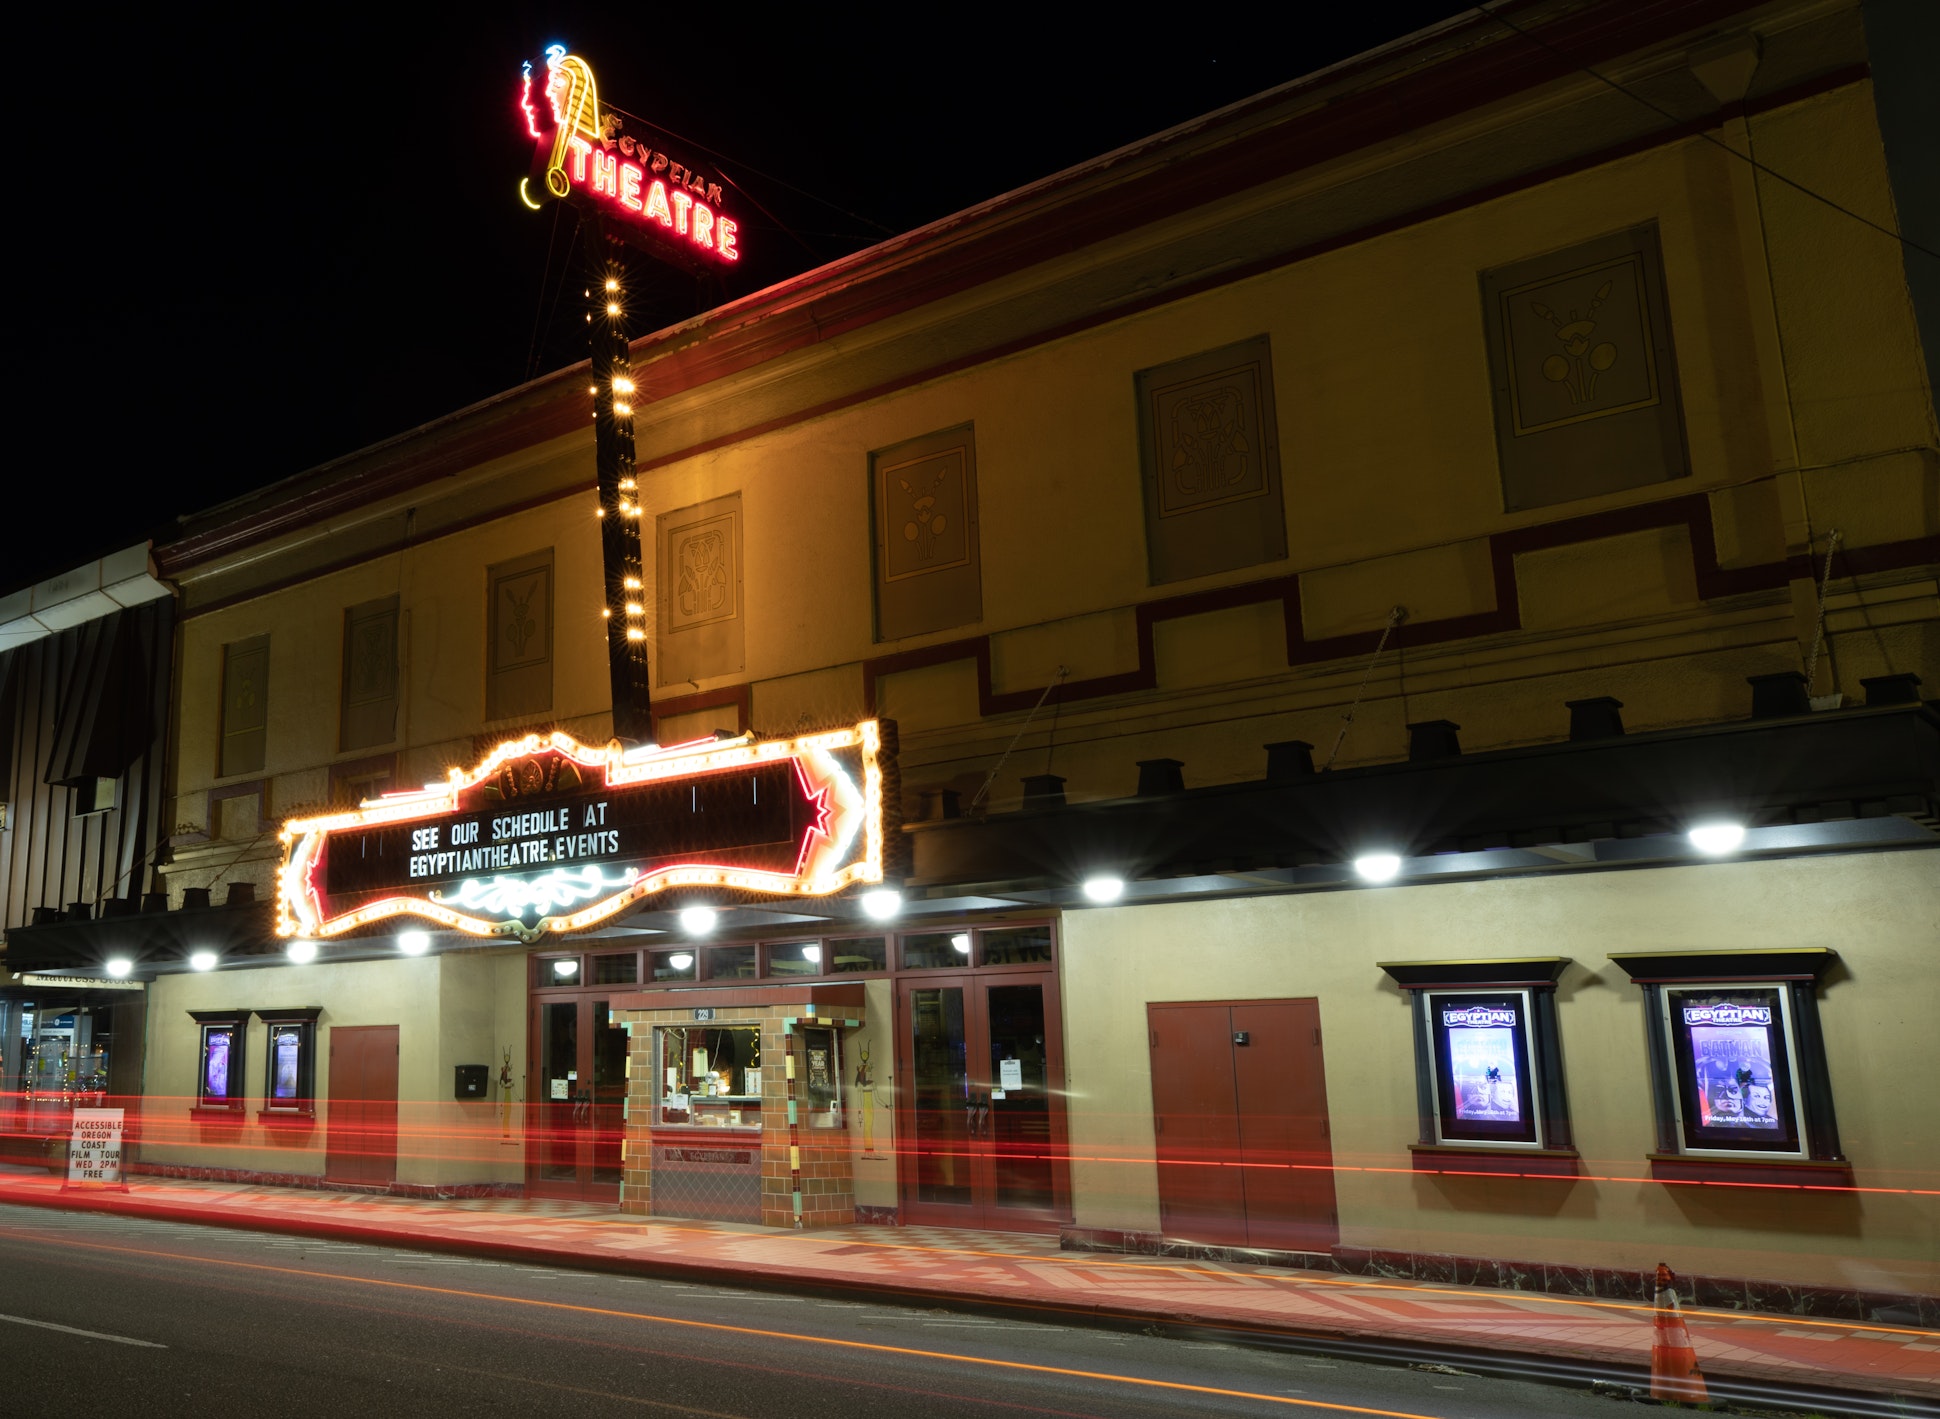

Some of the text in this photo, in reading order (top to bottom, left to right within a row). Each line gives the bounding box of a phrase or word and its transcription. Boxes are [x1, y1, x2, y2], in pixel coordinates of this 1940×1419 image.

[569, 136, 739, 261] THEATRE
[412, 802, 608, 851] SEE OUR SCHEDULE AT
[1449, 1012, 1510, 1022] EGYPTIAN
[1691, 1009, 1764, 1021] EGYPTIAN
[1701, 1039, 1762, 1057] BATMAN
[75, 1121, 122, 1130] ACCESSIBLE
[81, 1131, 112, 1139] OREGON
[81, 1141, 106, 1149] COAST
[71, 1150, 120, 1159] FILM TOUR
[75, 1160, 117, 1168] WED 2PM
[83, 1170, 103, 1178] FREE
